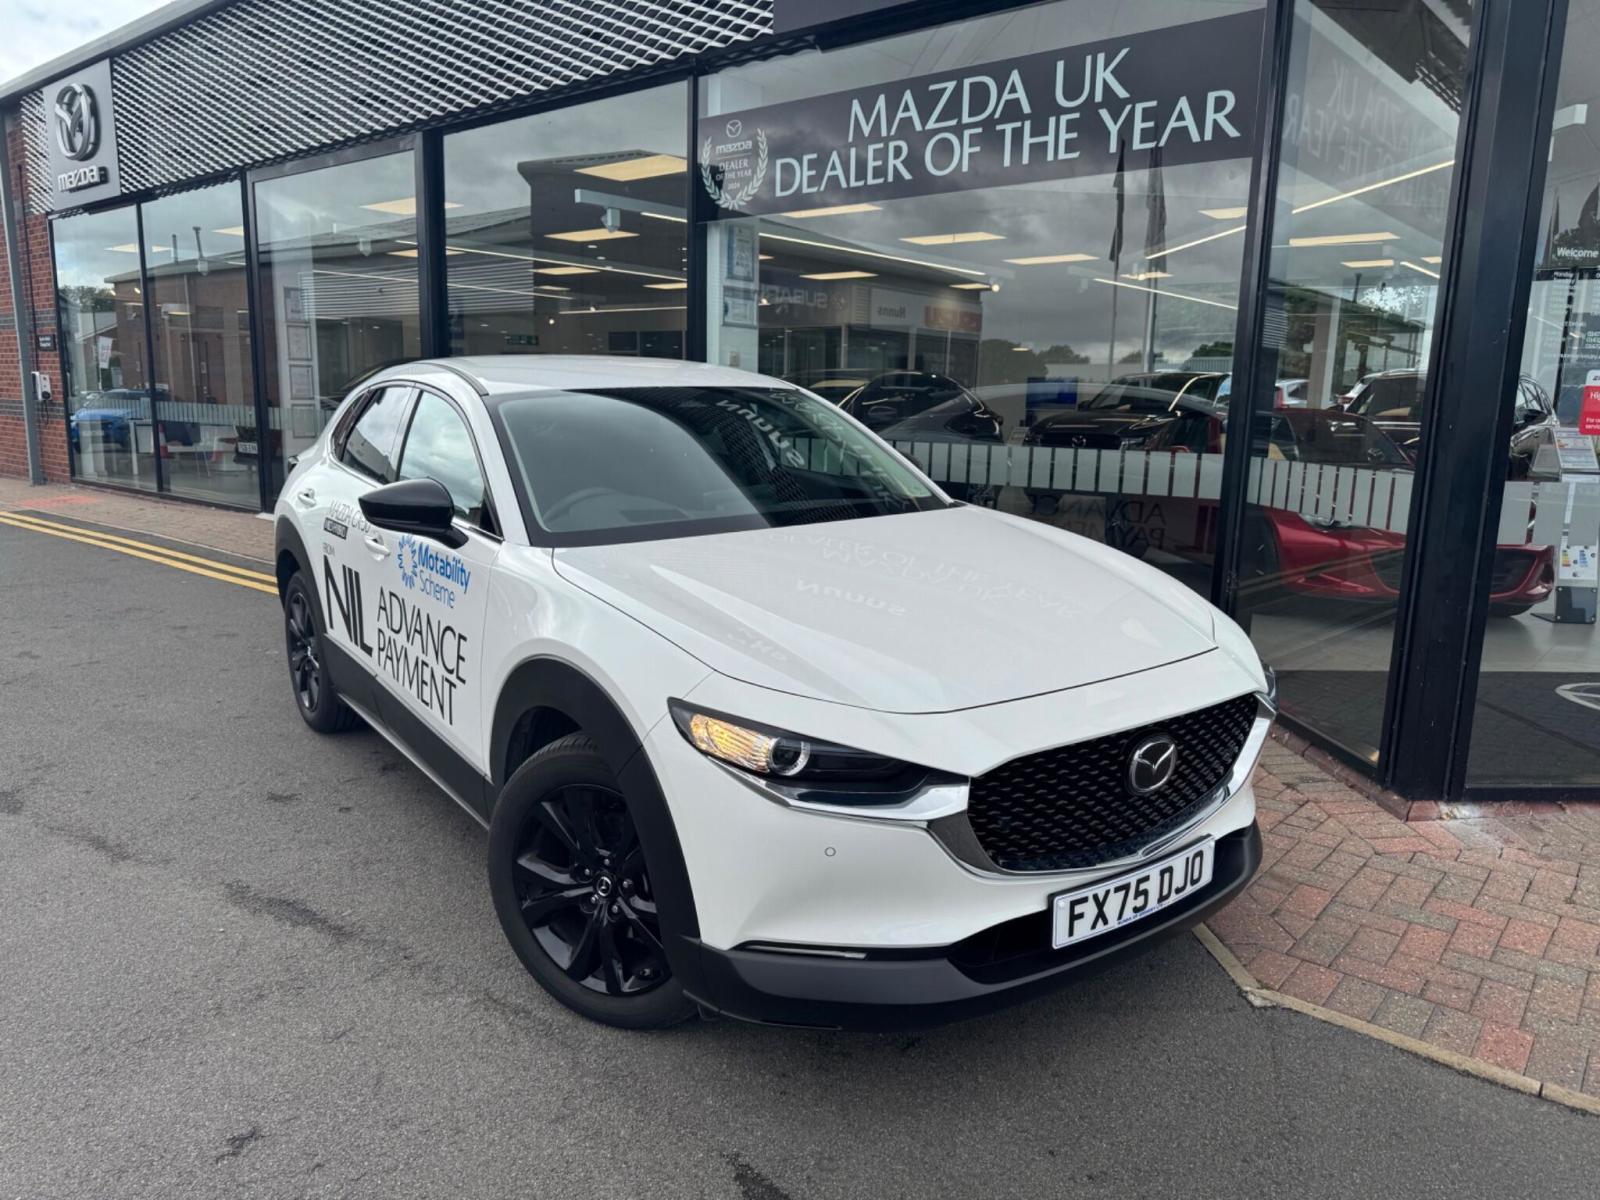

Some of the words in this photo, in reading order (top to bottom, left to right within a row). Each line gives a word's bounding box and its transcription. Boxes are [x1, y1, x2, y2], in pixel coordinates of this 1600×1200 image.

[848, 69, 1032, 143] MAZDA
[1055, 48, 1131, 108] UK
[715, 173, 724, 181] OF
[725, 171, 736, 180] THE
[737, 168, 753, 178] YEAR
[719, 158, 749, 171] DEALER
[775, 140, 913, 197] DEALER
[924, 127, 983, 177] OF
[996, 112, 1080, 167] THE
[1098, 90, 1241, 154] YEAR
[1556, 247, 1600, 258] Welcome
[323, 554, 373, 658] NIL
[418, 542, 471, 594] Motability
[419, 569, 455, 609] Scheme
[377, 585, 467, 685] ADVANCE
[377, 627, 457, 726] PAYMENT
[1068, 874, 1150, 938] FX75
[1157, 849, 1204, 904] DJO
